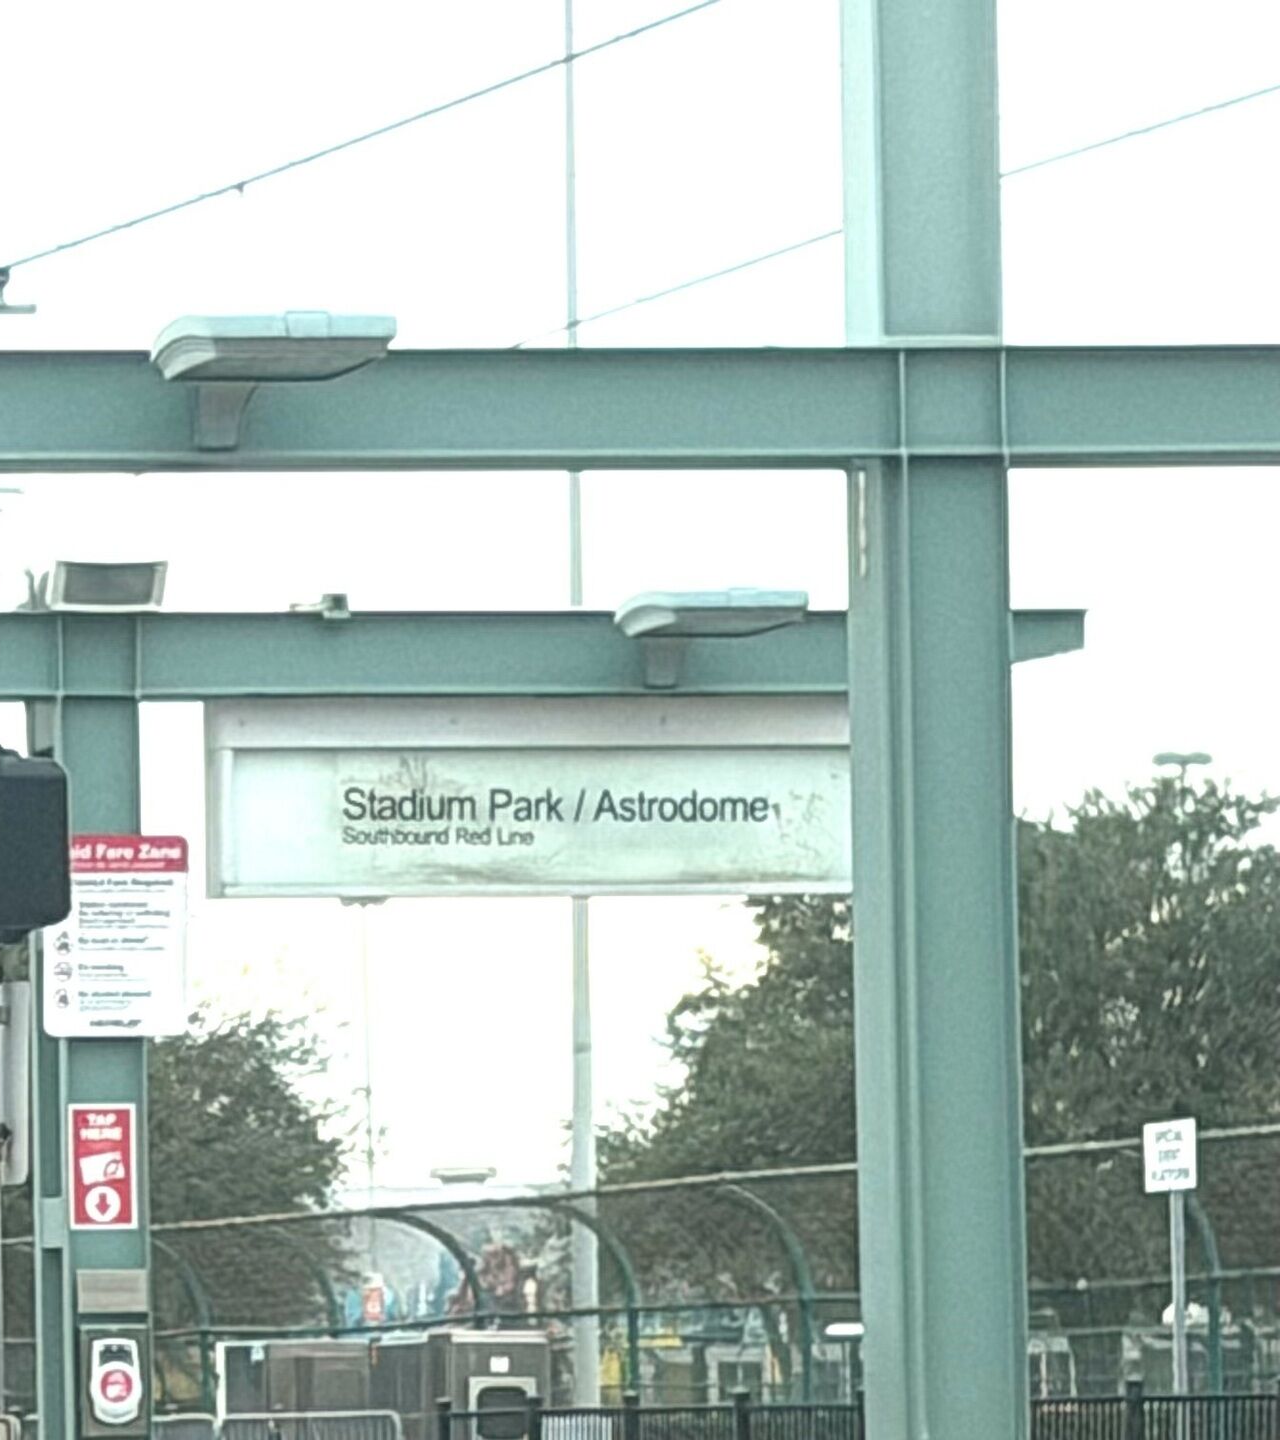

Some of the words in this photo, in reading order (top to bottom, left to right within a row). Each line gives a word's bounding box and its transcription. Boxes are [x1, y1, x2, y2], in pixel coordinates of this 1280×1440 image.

[342, 786, 476, 822] Stadium
[489, 787, 565, 823] Park
[573, 787, 587, 823] /
[592, 788, 770, 823] Astrodome
[342, 826, 450, 846] Southbound
[456, 827, 491, 846] Red
[497, 827, 535, 847] Line
[85, 1112, 118, 1126] TAP
[79, 1126, 123, 1141] HERE
